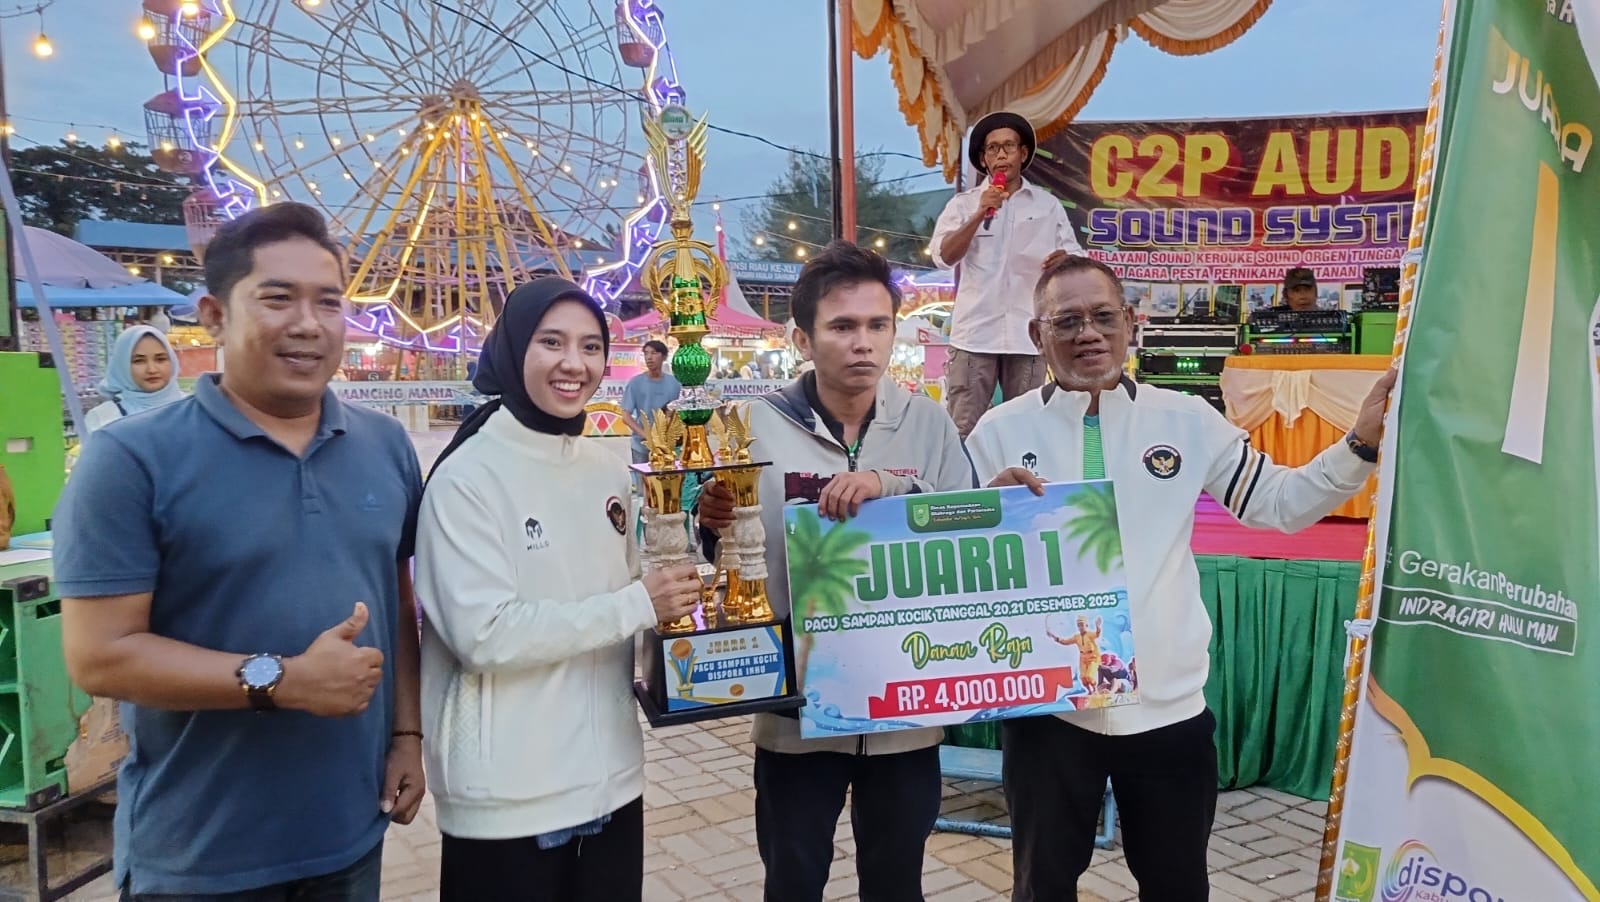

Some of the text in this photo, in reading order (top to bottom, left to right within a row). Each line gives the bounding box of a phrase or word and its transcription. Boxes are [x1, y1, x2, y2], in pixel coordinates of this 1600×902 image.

[1090, 133, 1230, 197] C2P
[1089, 208, 1254, 246] SOUND
[1088, 249, 1147, 264] MELAYANI
[1151, 252, 1192, 264] SOUND
[1257, 251, 1299, 264] SOUND
[1305, 250, 1347, 262] ORGEN
[1172, 267, 1209, 279] PESTA
[1214, 266, 1288, 280] PERNIKAHA
[1314, 265, 1356, 278] TANAN
[340, 387, 453, 399] MANCING MANIA
[723, 384, 770, 394] MANCING
[527, 540, 550, 551] MILLS
[855, 530, 1063, 602] JUARA 1
[804, 617, 838, 632] PACU
[841, 611, 894, 629] SAMPAN
[897, 608, 933, 623] KOCIK
[935, 603, 991, 621] TANGGAL
[1027, 597, 1086, 613] DESEMBER
[1089, 594, 1117, 608] 2025
[1398, 597, 1559, 644] INDRAGIRI HULU MAJU
[706, 636, 759, 654] JUARA 1
[902, 622, 1032, 669] Danau Raja
[693, 653, 778, 673] PACU SAMPAN KOCIK
[707, 664, 766, 681] DISPORA INHU
[897, 684, 929, 712] RP.
